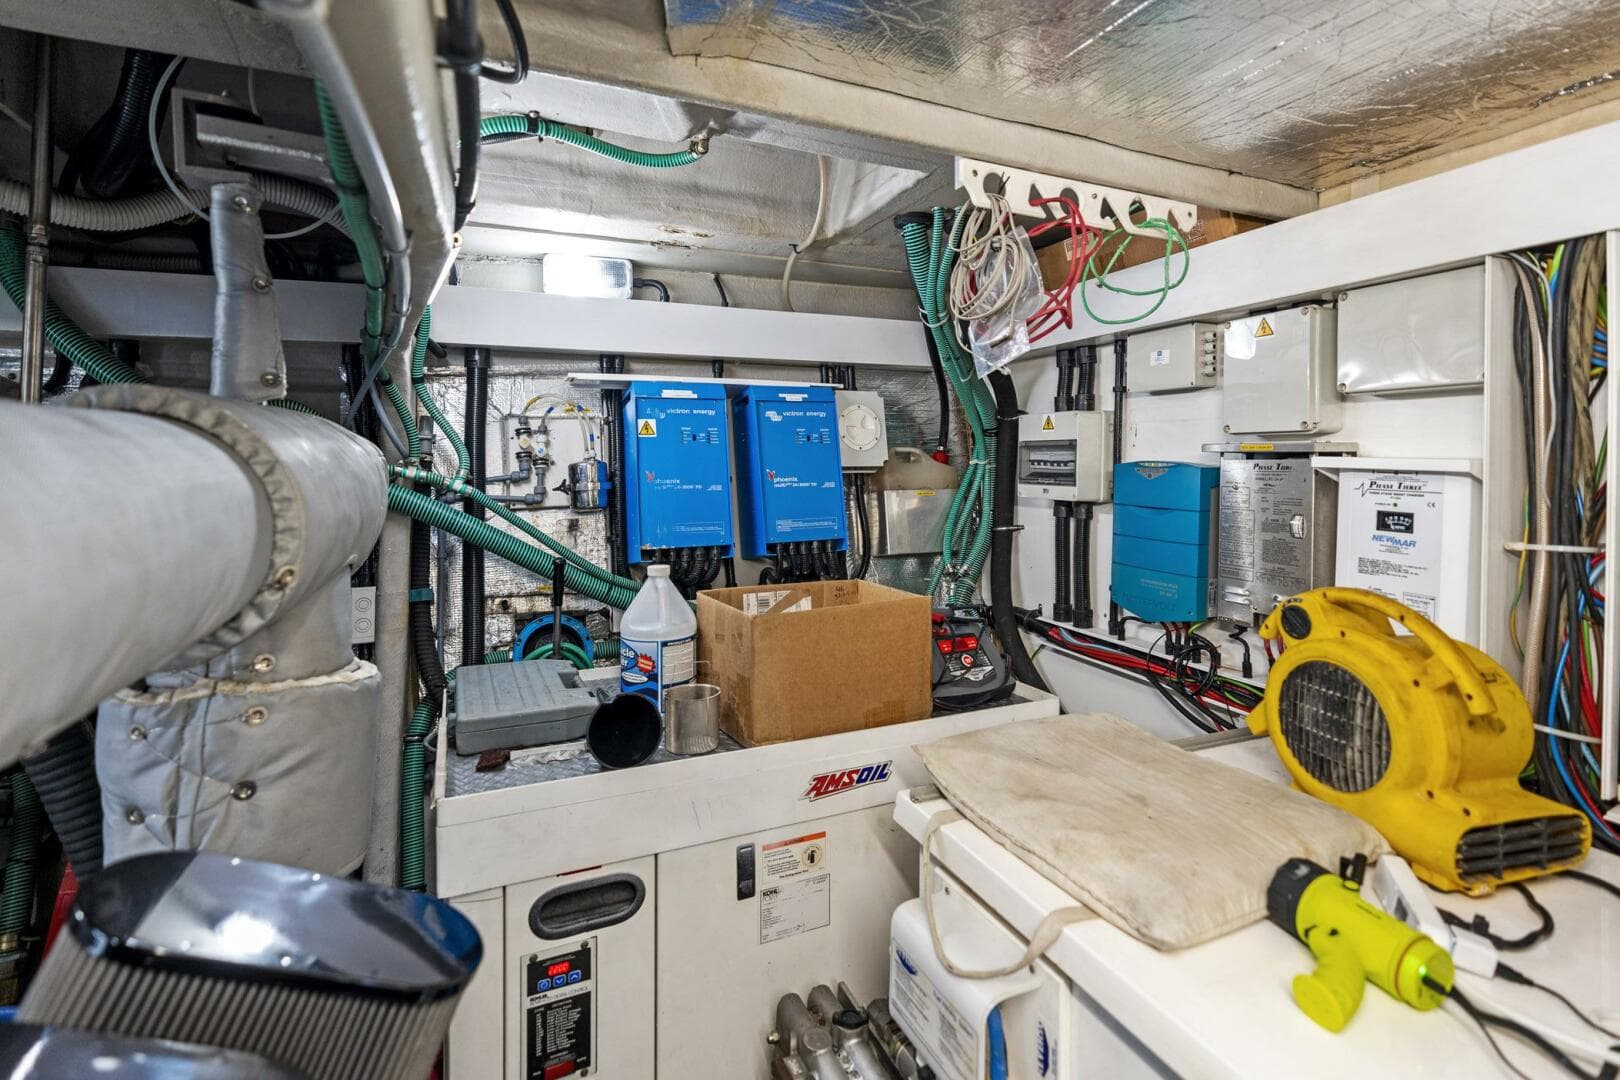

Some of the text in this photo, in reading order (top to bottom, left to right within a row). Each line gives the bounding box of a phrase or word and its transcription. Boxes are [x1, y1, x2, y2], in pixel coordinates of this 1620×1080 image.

[773, 476, 798, 484] phoenix
[1371, 534, 1417, 548] NEWMAR
[804, 763, 889, 799] AMSOIL
